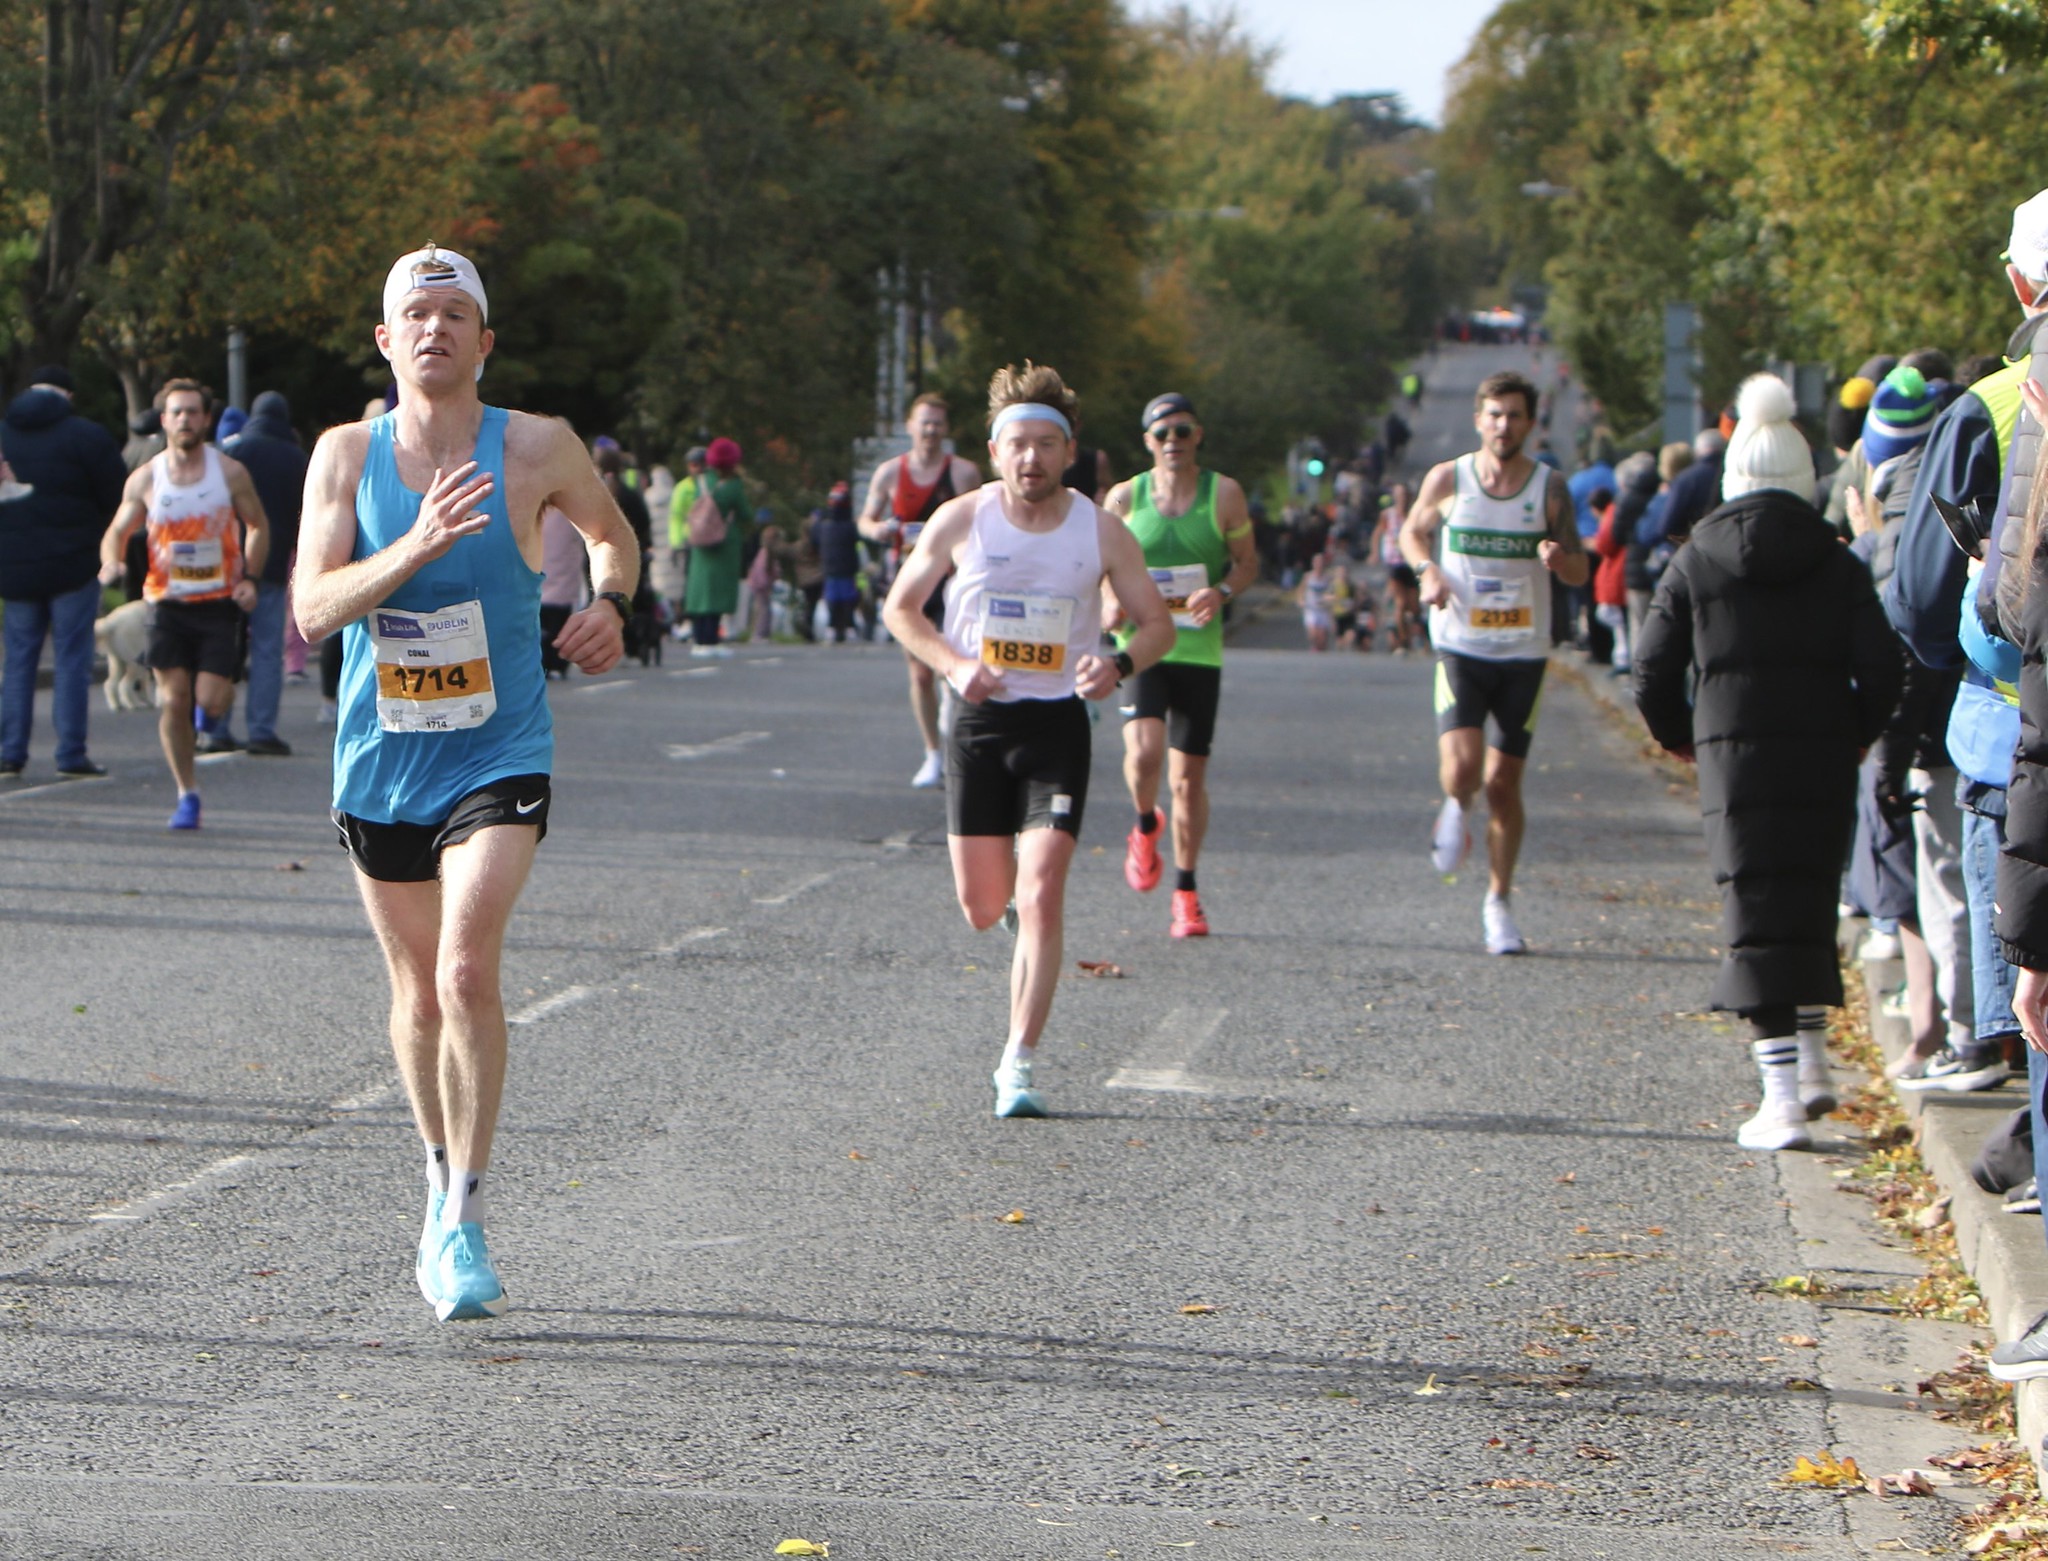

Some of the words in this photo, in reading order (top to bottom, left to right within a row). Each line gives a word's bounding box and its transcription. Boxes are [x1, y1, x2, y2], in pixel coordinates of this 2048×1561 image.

[1458, 533, 1534, 552] RAHENY
[427, 617, 469, 632] DUBLIN
[990, 640, 1054, 665] 1838
[394, 665, 469, 693] 1714
[425, 720, 448, 729] 1714
